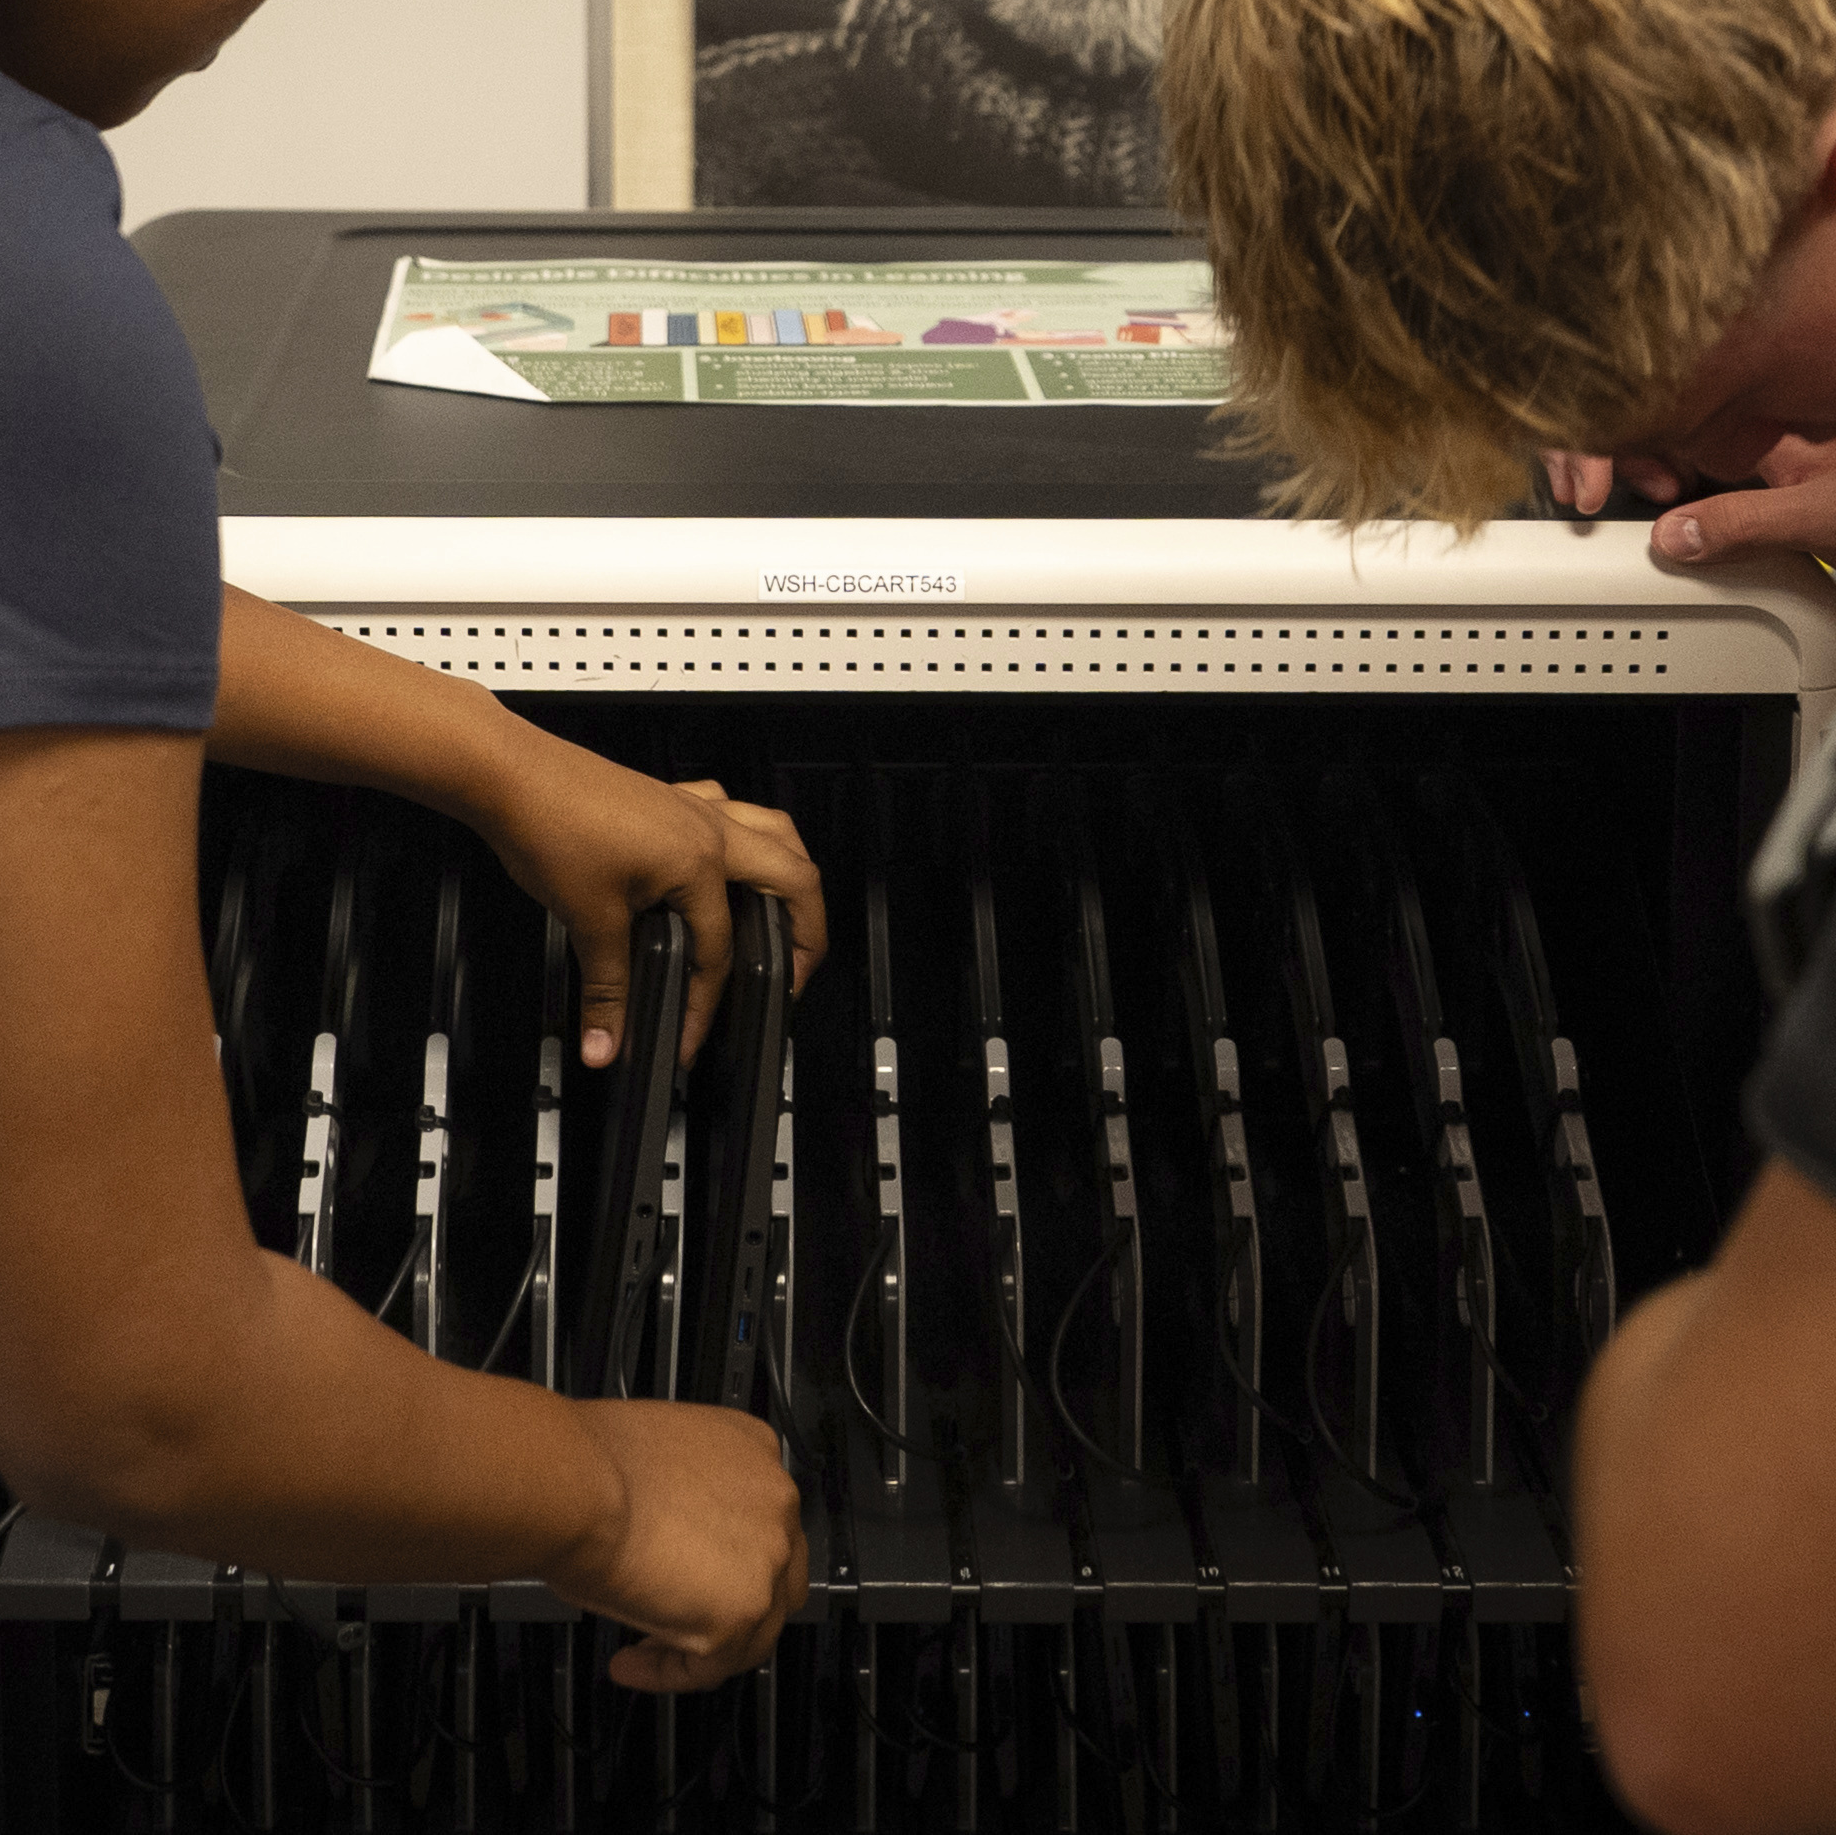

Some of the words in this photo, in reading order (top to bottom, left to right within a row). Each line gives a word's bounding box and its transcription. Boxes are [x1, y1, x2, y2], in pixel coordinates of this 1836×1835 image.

[607, 267, 810, 283] Difficulties
[865, 268, 1026, 283] Learning
[764, 574, 957, 593] WSH-CBCART543
